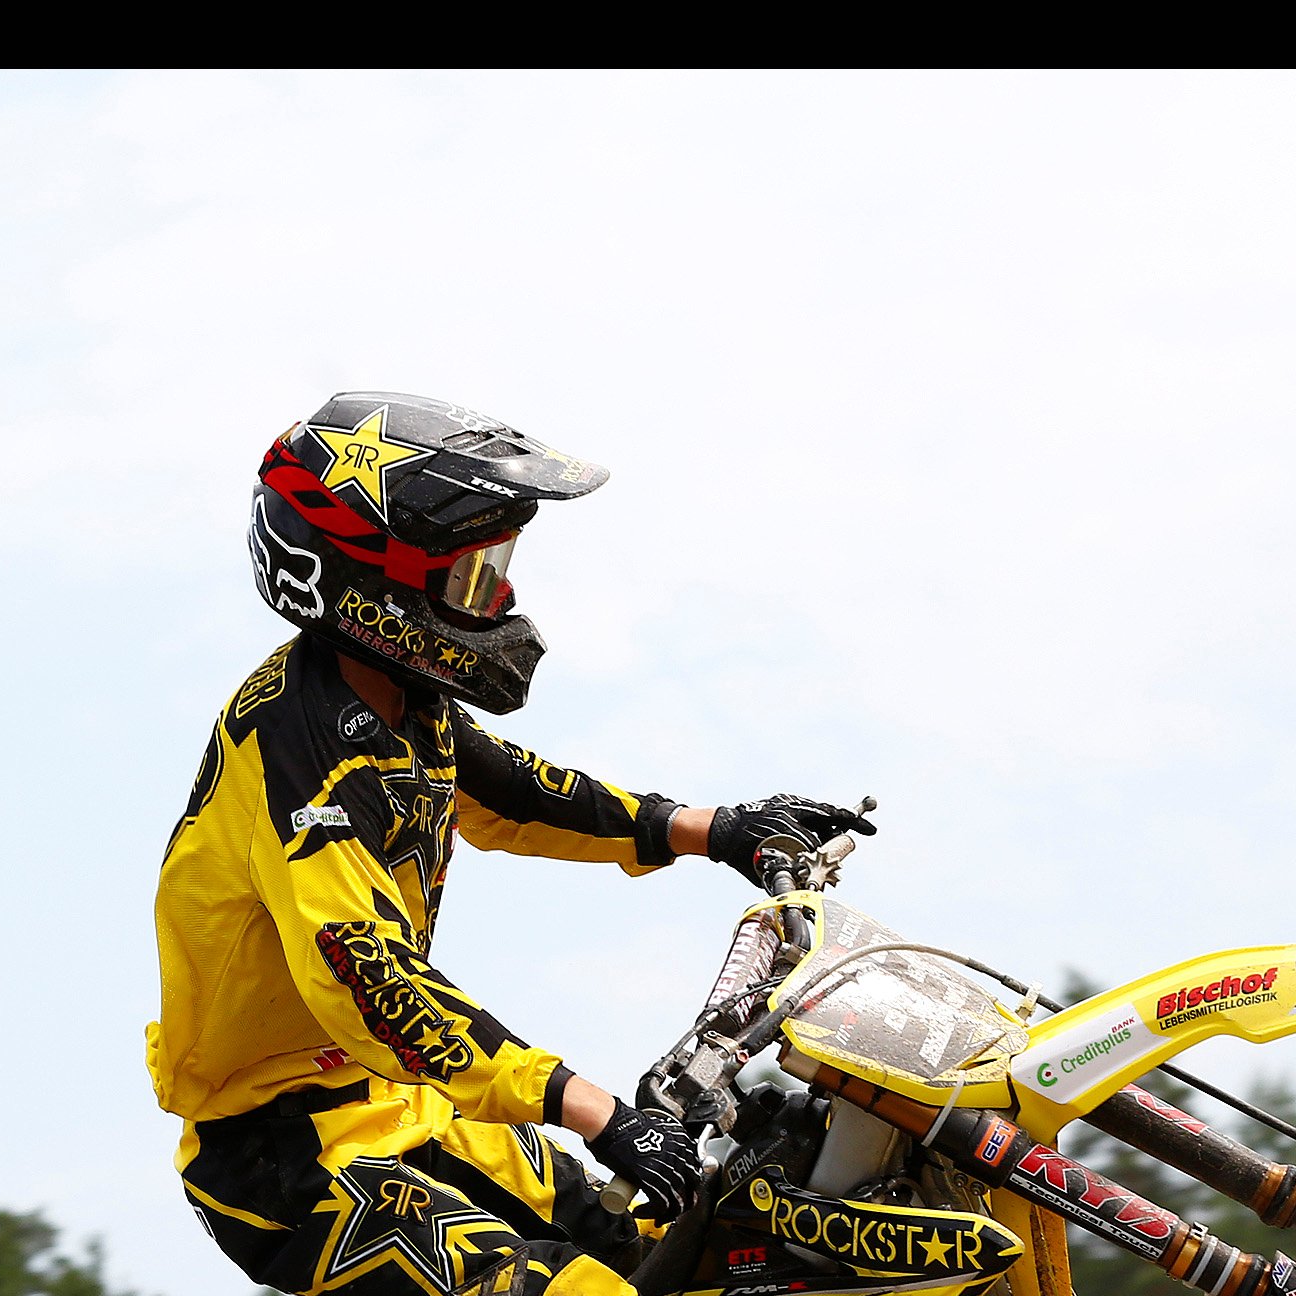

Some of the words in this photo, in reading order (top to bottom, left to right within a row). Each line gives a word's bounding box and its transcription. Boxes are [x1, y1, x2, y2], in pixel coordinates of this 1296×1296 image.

[470, 475, 520, 499] FOX
[340, 617, 407, 660] ENERGY
[709, 919, 764, 1005] RENTHA
[1156, 967, 1279, 1020] Bischof
[1158, 991, 1279, 1031] LEBENSMITTELLOGISTIK
[1111, 1016, 1135, 1034] BANK
[1060, 1025, 1132, 1075] Creditplus
[980, 1119, 1010, 1163] GET
[1016, 1143, 1180, 1240] KYB
[1026, 1181, 1104, 1227] Technical
[1108, 1225, 1161, 1257] Touch
[728, 1247, 767, 1266] ETS
